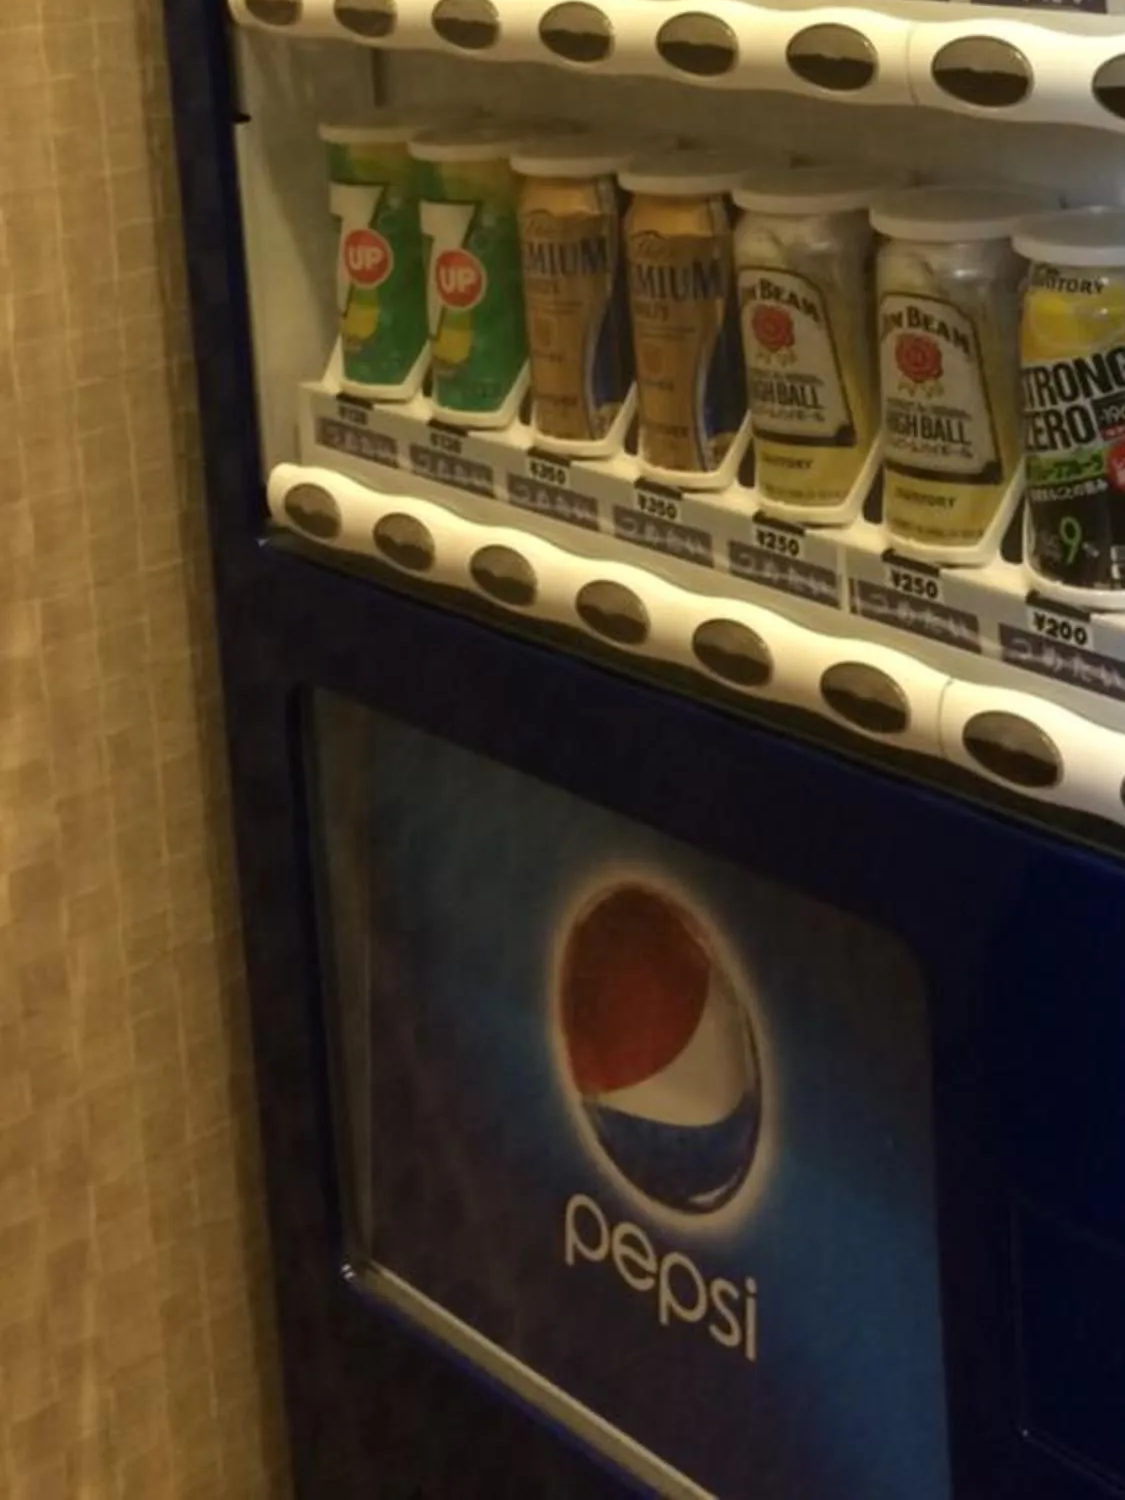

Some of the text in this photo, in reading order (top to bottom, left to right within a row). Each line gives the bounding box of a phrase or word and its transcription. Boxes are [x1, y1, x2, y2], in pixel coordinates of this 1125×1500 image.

[347, 245, 383, 271] UP
[437, 266, 476, 294] UP
[891, 570, 940, 600] ¥250
[1033, 611, 1088, 646] ¥200
[564, 1192, 758, 1363] pepsi
